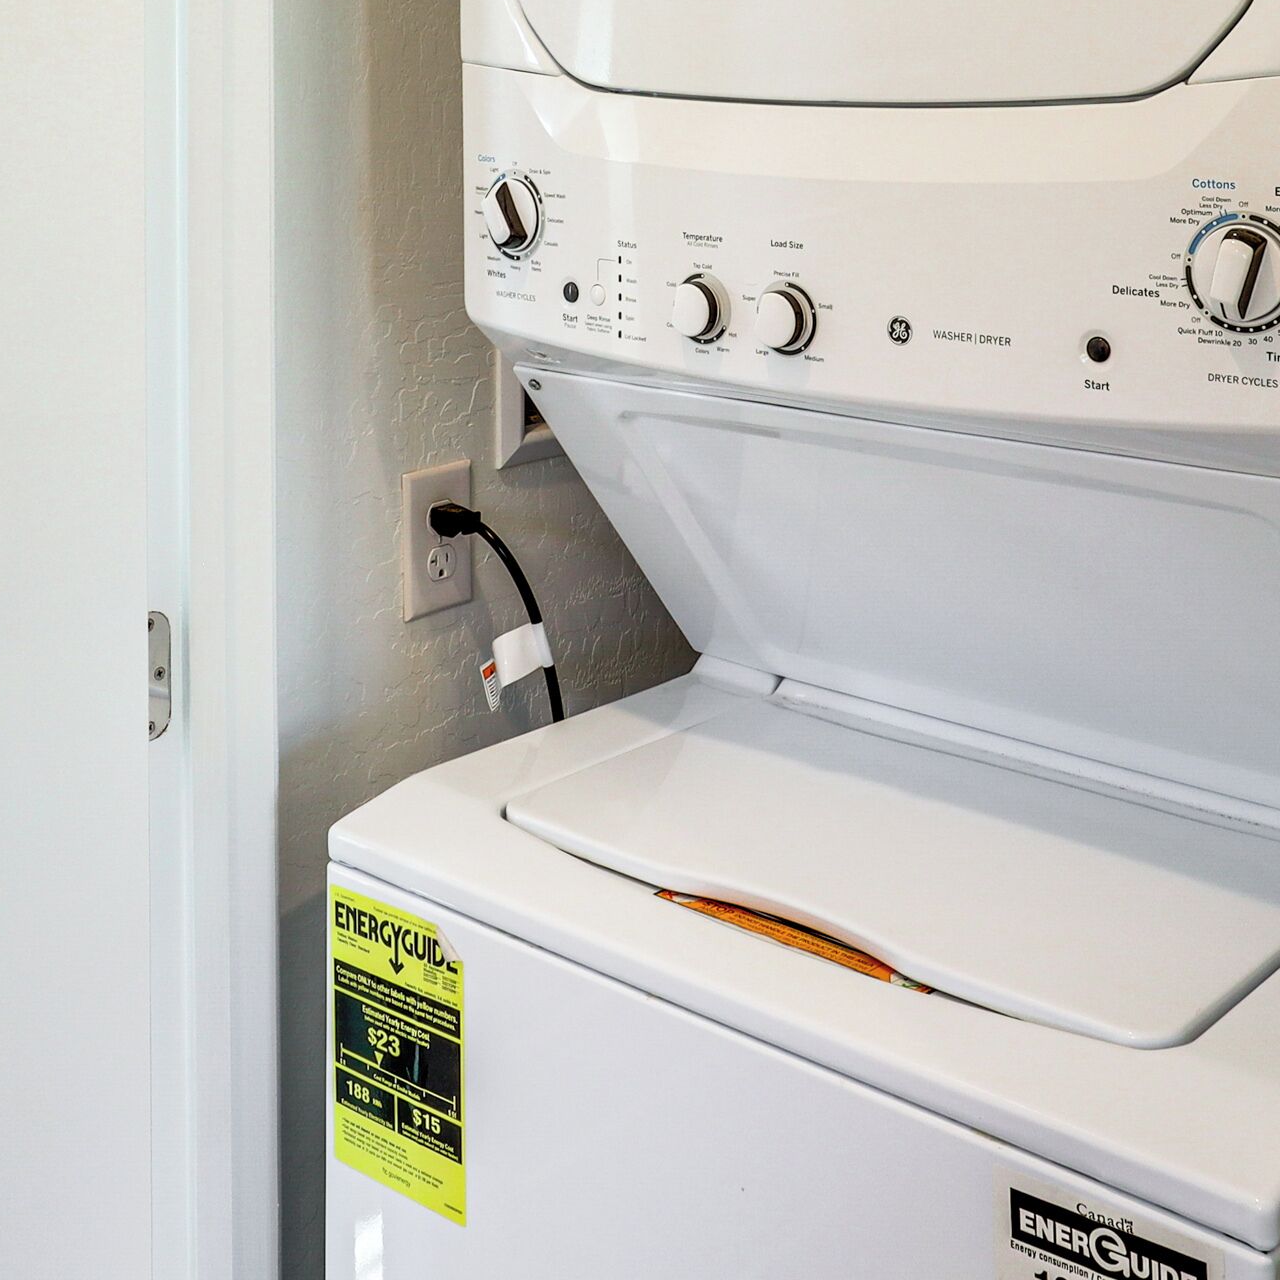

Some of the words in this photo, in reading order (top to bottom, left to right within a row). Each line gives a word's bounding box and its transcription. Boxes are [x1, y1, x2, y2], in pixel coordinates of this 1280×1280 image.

[478, 154, 495, 163] Colors
[1192, 179, 1236, 190] Cottons
[1189, 218, 1200, 226] Dry
[683, 232, 723, 243] Temperature
[617, 240, 637, 249] Status
[771, 240, 787, 248] Load
[789, 241, 804, 250] Size
[487, 270, 506, 279] Whites
[774, 270, 791, 278] Precise
[1112, 285, 1160, 298] Delicates
[1160, 300, 1177, 308] More
[1179, 301, 1191, 309] Dry
[562, 313, 578, 323] Start
[1178, 327, 1197, 335] Quick
[933, 330, 973, 343] WASHER
[980, 335, 1012, 347] DRYER
[1198, 337, 1231, 346] Dewrinkle
[804, 354, 825, 363] Medium
[1084, 380, 1111, 392] Start
[1208, 373, 1240, 385] DRYER
[1242, 377, 1279, 388] CYCLES
[336, 965, 357, 981] Compare
[358, 975, 371, 987] ONLY
[377, 982, 390, 995] other
[391, 988, 406, 1001] labels
[417, 999, 433, 1014] yellow
[362, 1004, 385, 1022] Estimated
[385, 1014, 401, 1030] Yearly
[400, 1022, 418, 1038] Energy
[368, 1026, 401, 1057] $23
[346, 1080, 370, 1104] 188
[413, 1109, 441, 1135] $15
[1076, 1203, 1134, 1235] Canada
[1010, 1239, 1037, 1259] Energy
